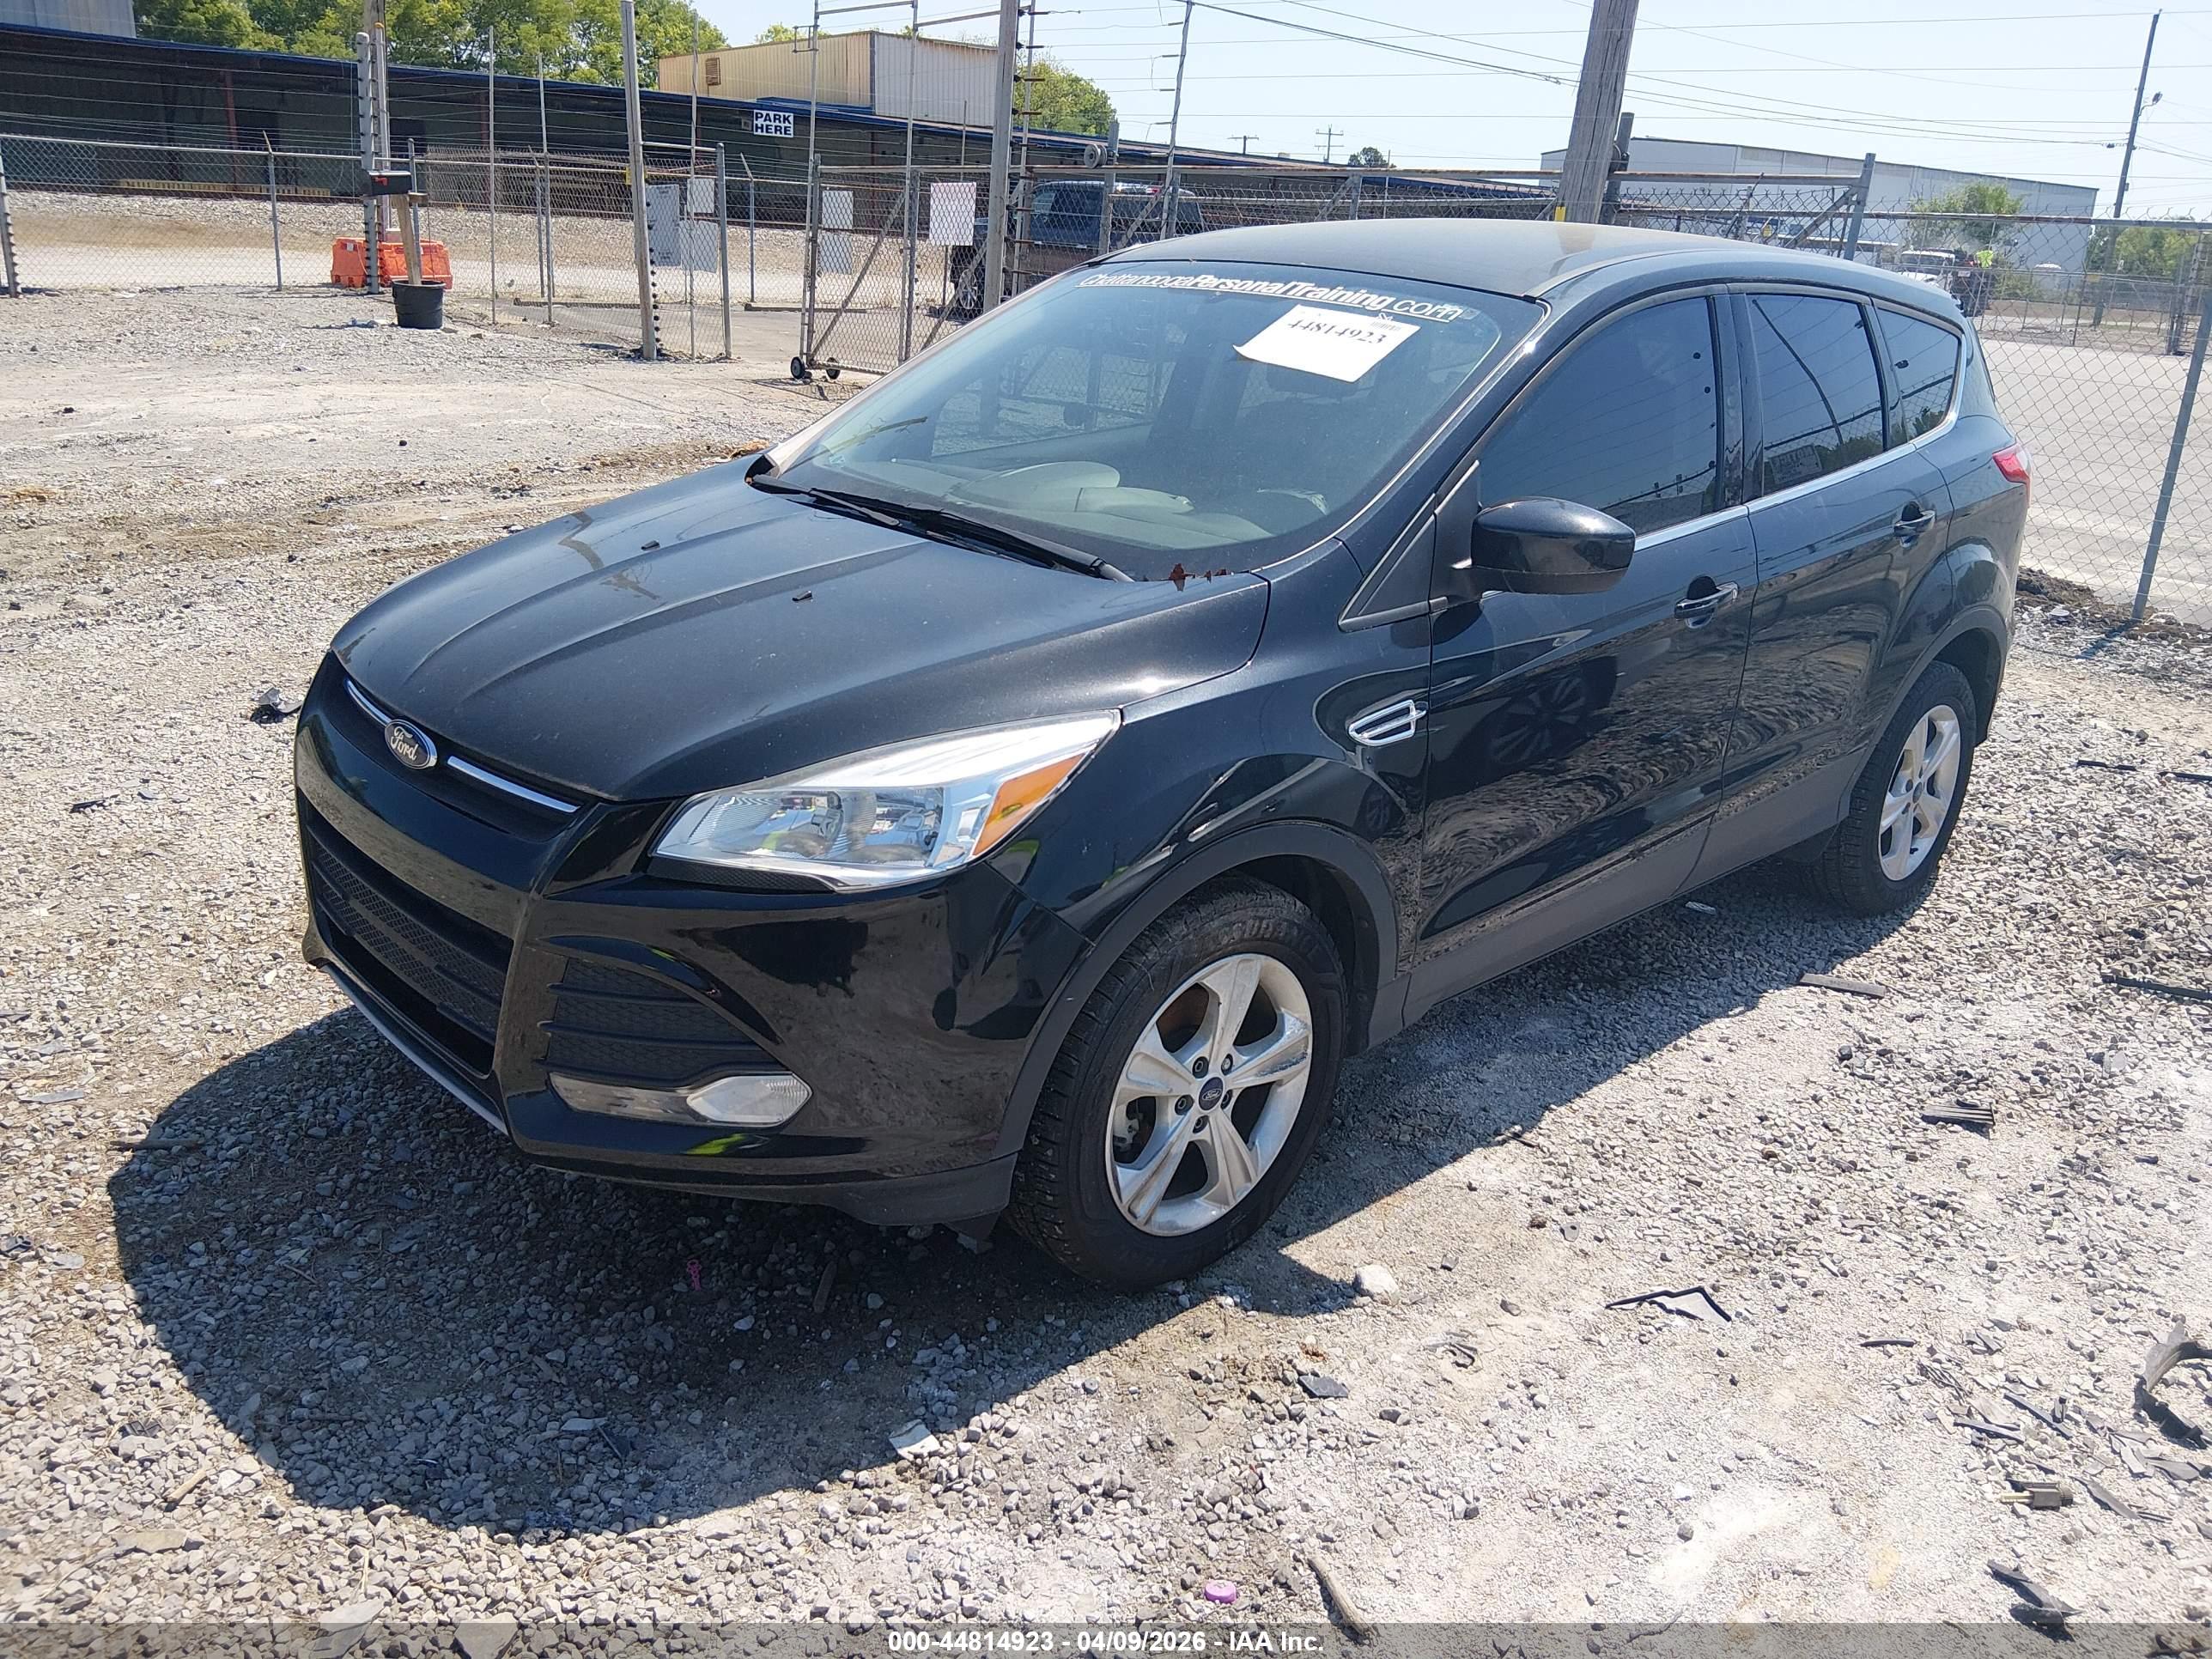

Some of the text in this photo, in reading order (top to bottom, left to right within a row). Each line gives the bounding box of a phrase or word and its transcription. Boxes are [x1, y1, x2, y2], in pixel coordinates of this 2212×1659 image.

[755, 112, 792, 125] PARK
[755, 123, 792, 136] HERE
[1286, 319, 1388, 344] 44814923
[390, 726, 419, 761] Ford
